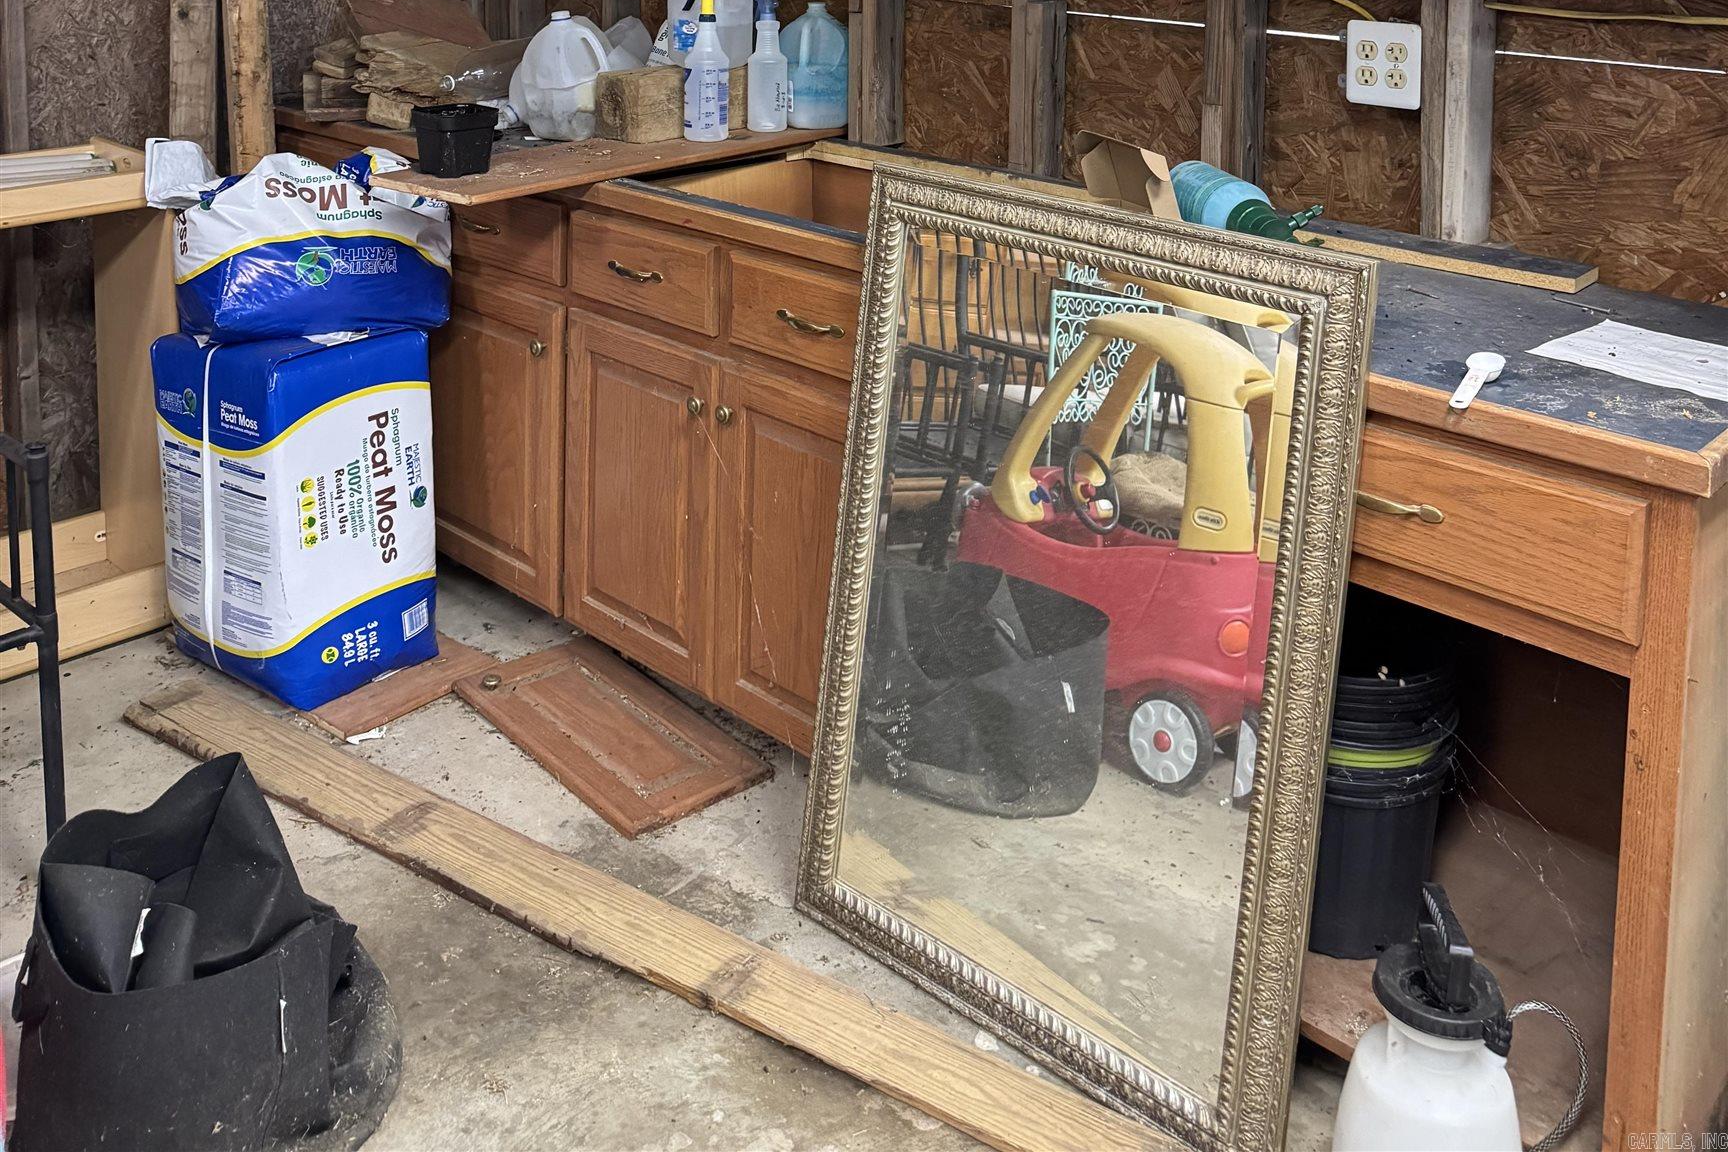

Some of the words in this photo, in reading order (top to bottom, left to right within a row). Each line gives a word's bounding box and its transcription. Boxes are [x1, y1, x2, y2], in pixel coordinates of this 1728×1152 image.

[264, 178, 348, 211] Moss
[316, 208, 383, 222] Sphagnum
[176, 211, 189, 256] oss
[339, 246, 397, 261] EARTH
[338, 260, 398, 275] MAJESTIC
[220, 408, 238, 425] Peat
[238, 413, 258, 430] Moss
[367, 410, 393, 479] Peat
[391, 407, 402, 466] Sphagnum
[404, 445, 415, 487] EARTH
[412, 442, 422, 484] MAJESTIC
[316, 475, 328, 520] SUGGESTED
[334, 468, 345, 502] Ready
[346, 459, 363, 497] 100%
[355, 497, 365, 533] Organic
[337, 502, 344, 514] to
[320, 520, 329, 542] USES
[338, 514, 349, 535] Use
[374, 484, 398, 564] Moss
[367, 620, 379, 630] 3
[341, 632, 356, 659] 84.9
[355, 626, 369, 663] LARGE
[368, 631, 378, 648] cu.
[344, 658, 356, 668] L
[369, 647, 381, 662] ft.
